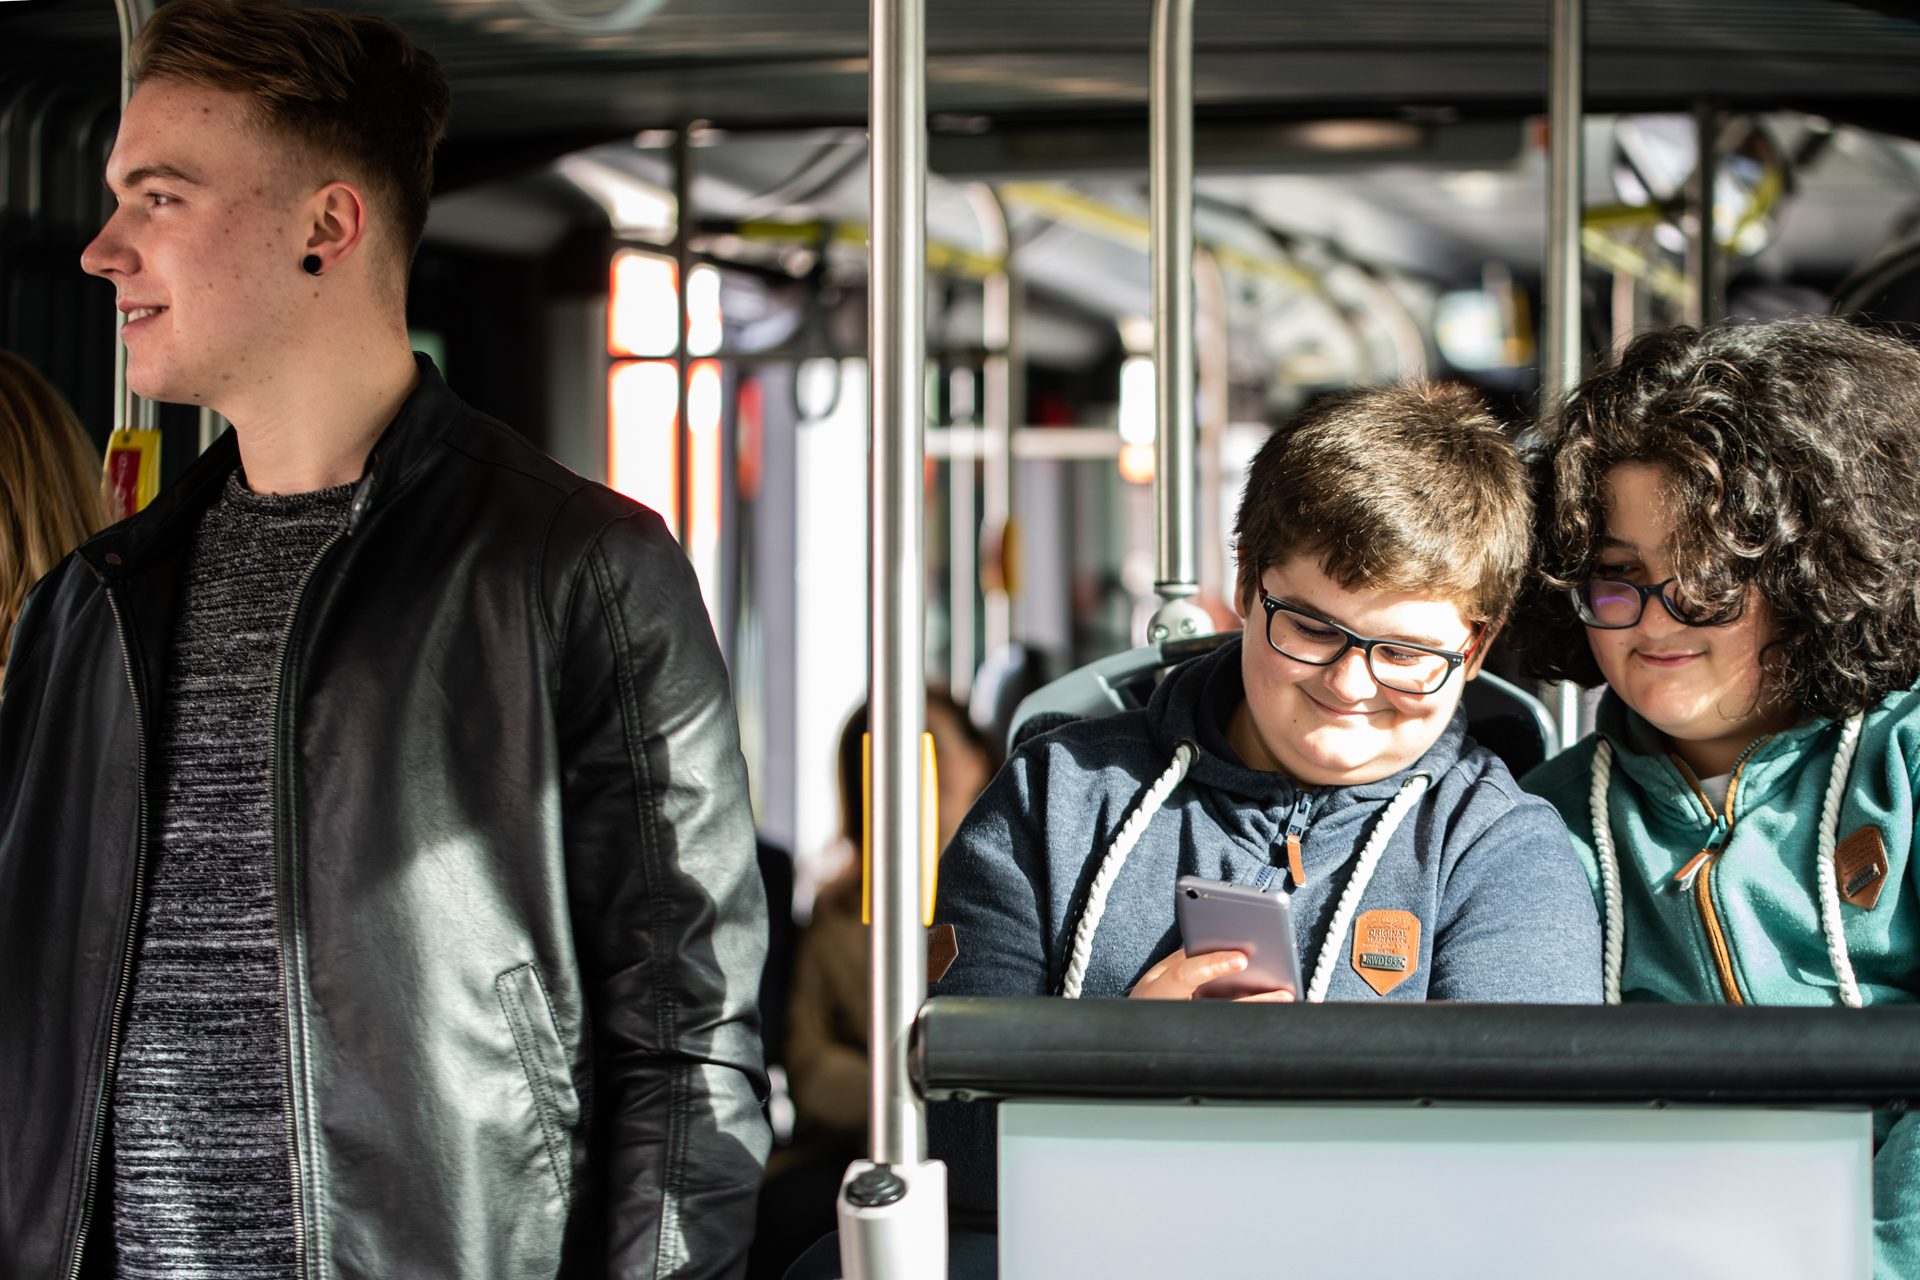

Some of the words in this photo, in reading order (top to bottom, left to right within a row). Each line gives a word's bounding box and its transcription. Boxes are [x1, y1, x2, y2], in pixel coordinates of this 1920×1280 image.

[1844, 844, 1873, 864] ORIGINAL
[1367, 929, 1405, 938] ORIGINAL
[1367, 936, 1406, 944] TRADEMARK
